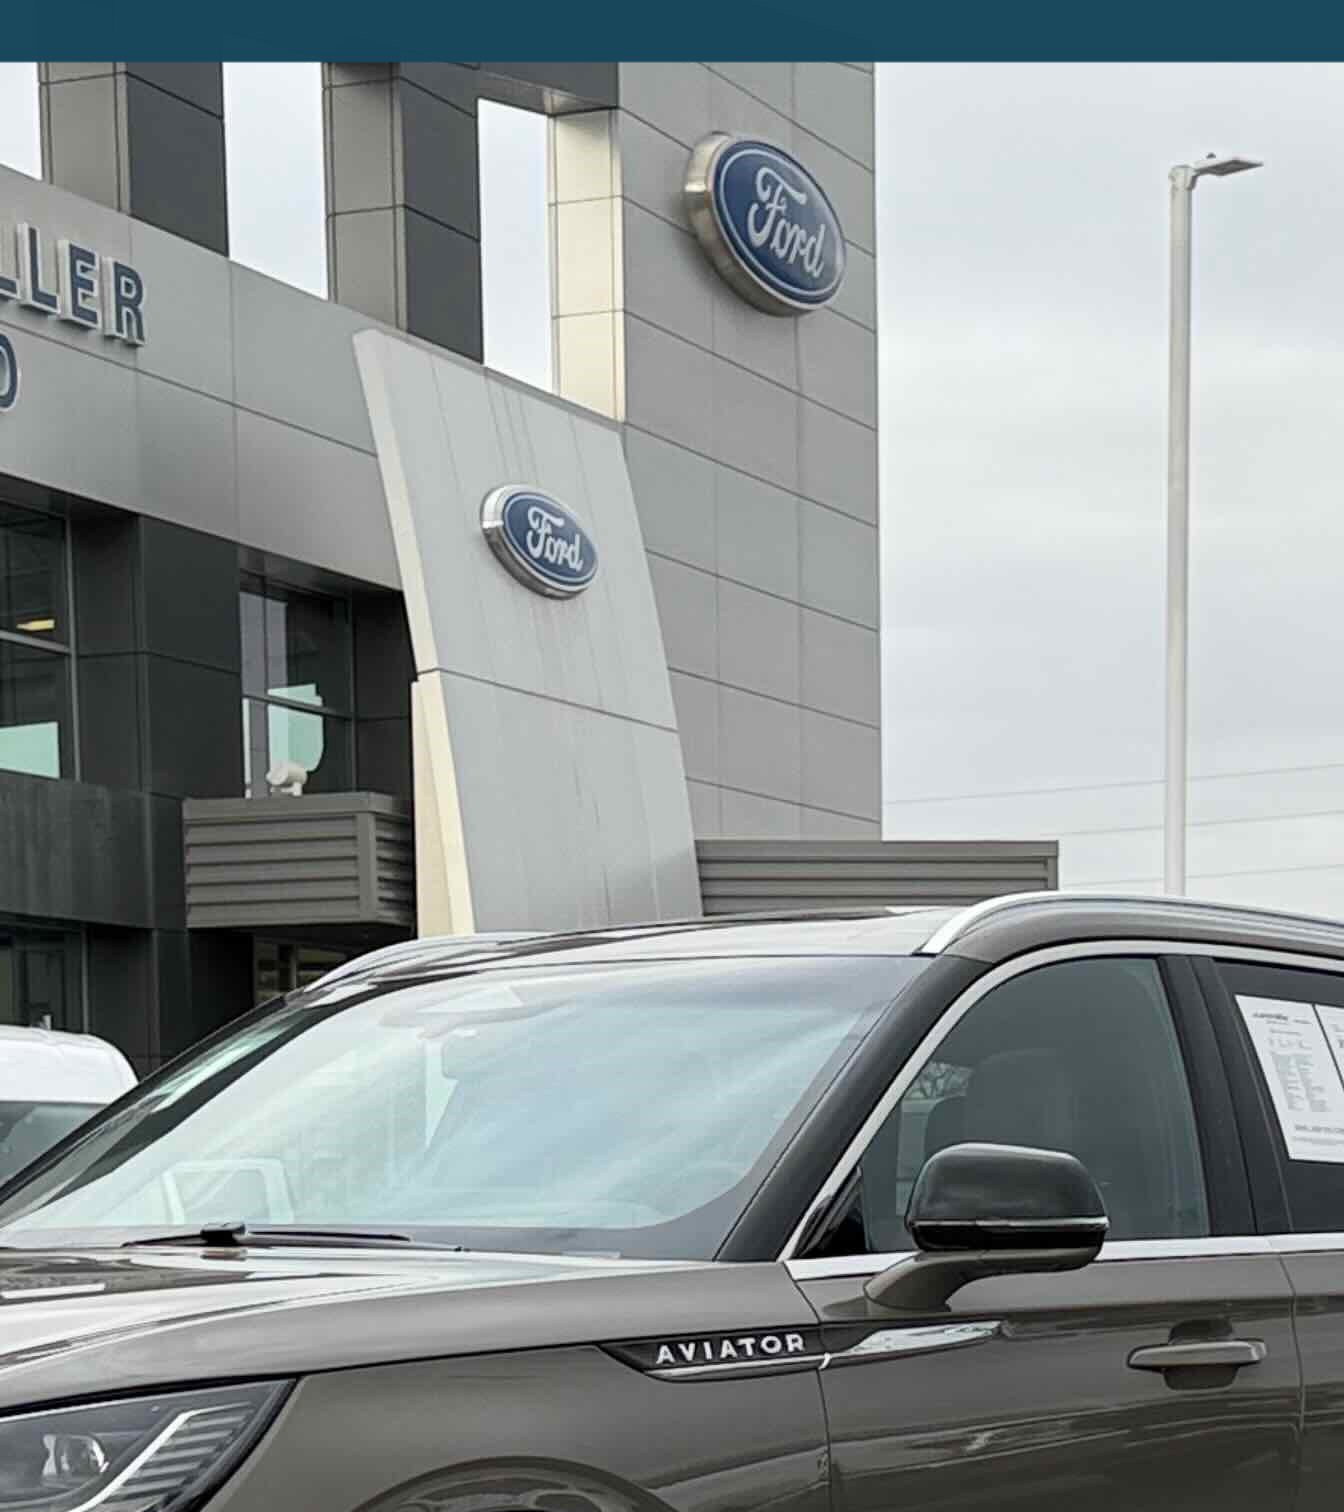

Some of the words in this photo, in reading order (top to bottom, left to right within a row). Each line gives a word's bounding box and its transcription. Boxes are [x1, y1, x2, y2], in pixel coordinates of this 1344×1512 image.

[747, 166, 826, 279] Ford
[526, 506, 584, 572] Ford
[656, 1333, 805, 1364] AVIATOR
